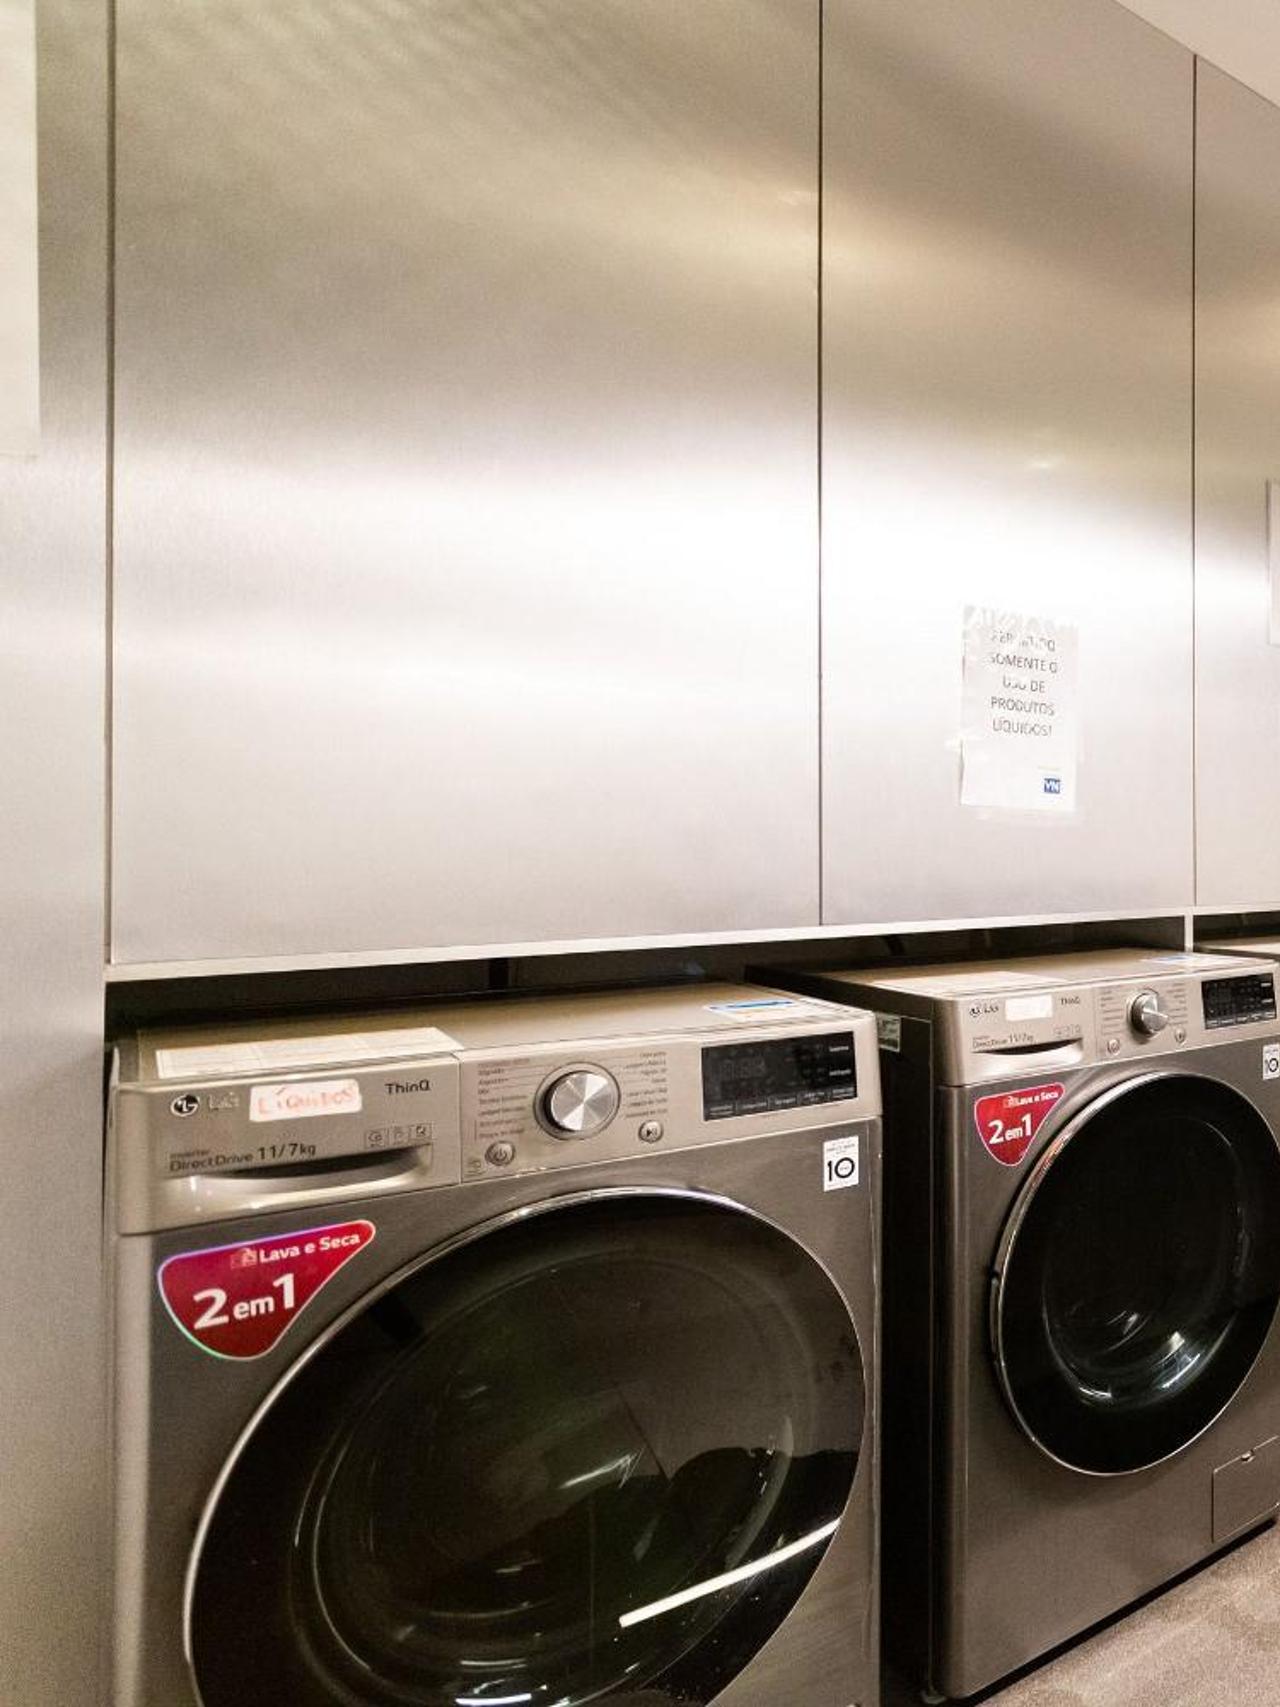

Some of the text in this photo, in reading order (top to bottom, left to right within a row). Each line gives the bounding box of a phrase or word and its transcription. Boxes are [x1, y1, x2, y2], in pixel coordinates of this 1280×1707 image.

[1030, 680, 1045, 693] DE
[990, 696, 1055, 716] PRODUTOS
[385, 1079, 431, 1095] ThinQ
[988, 1113, 1032, 1145] 2 em 1
[258, 1233, 361, 1263] Lava e Seca
[193, 1273, 295, 1330] 2 em 1
